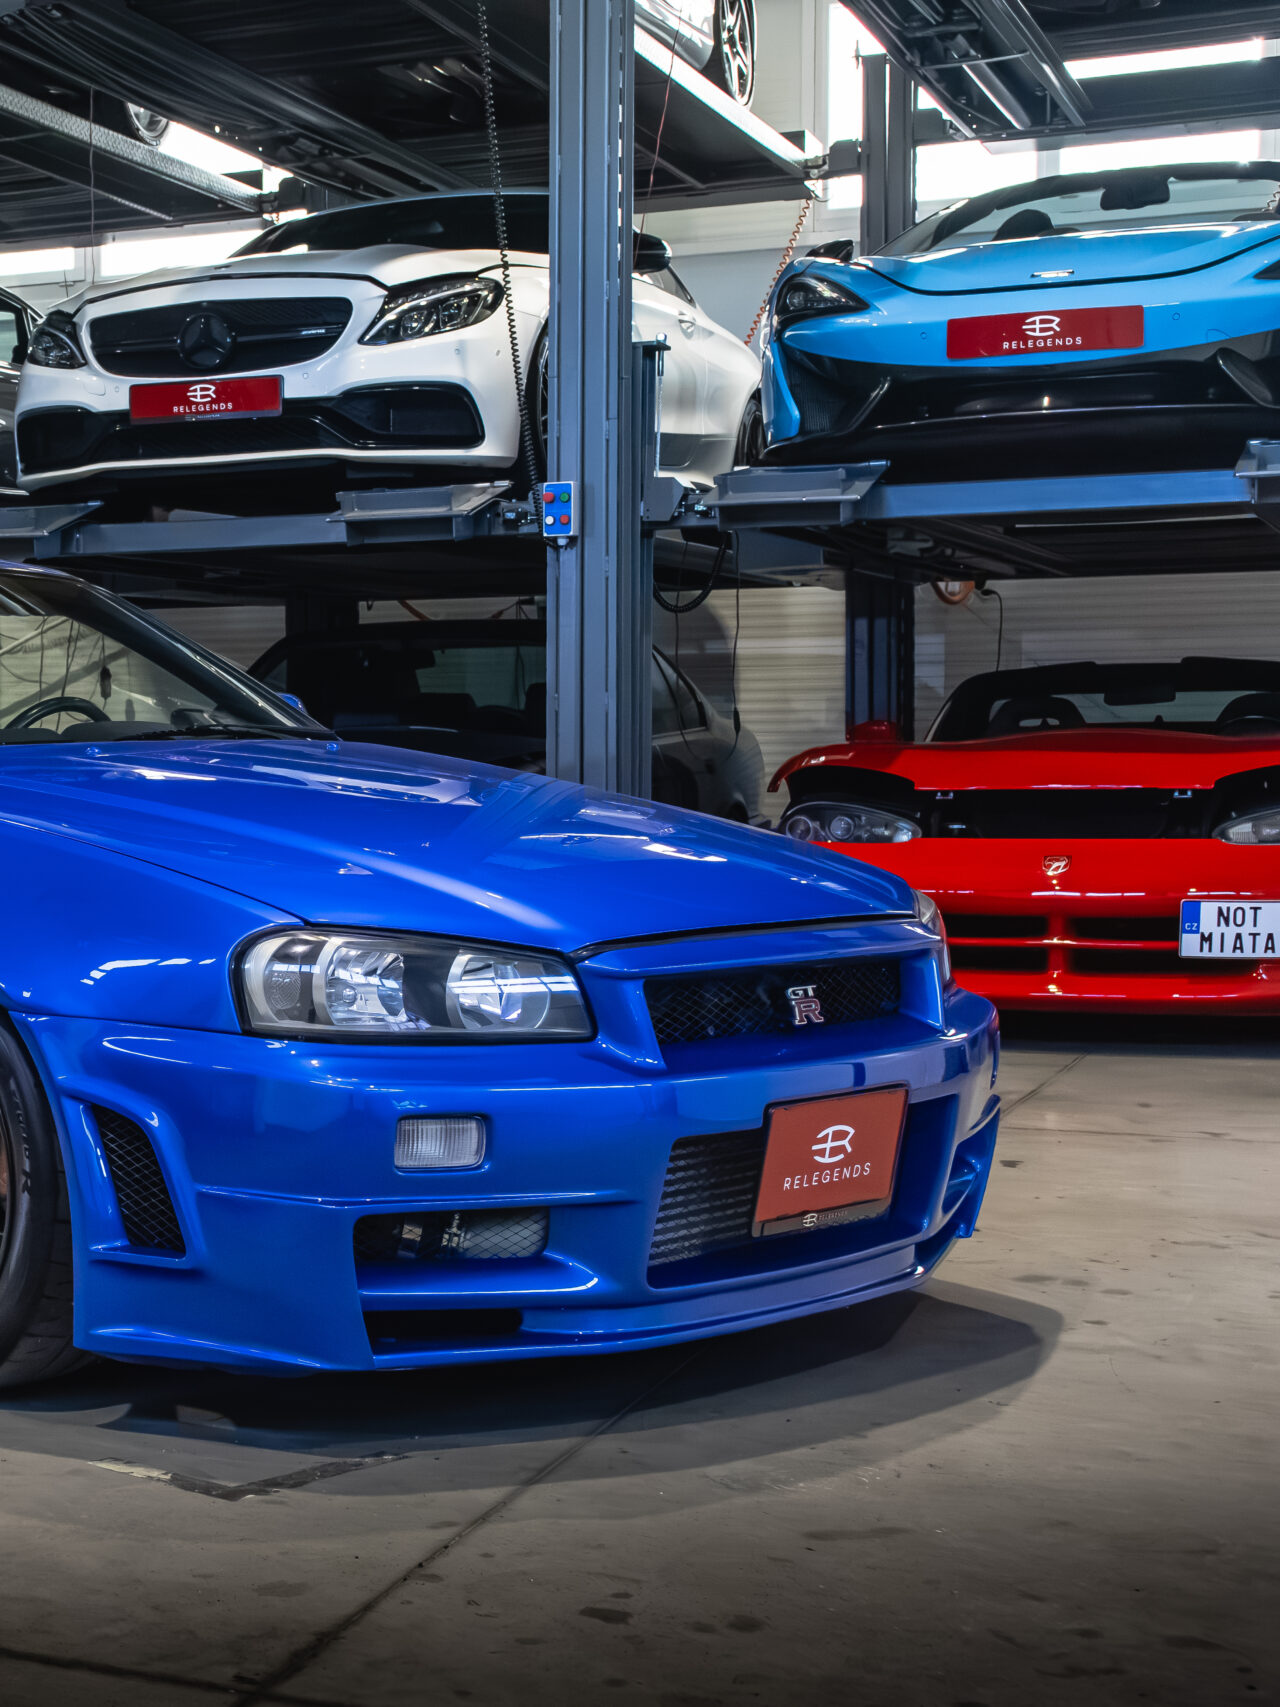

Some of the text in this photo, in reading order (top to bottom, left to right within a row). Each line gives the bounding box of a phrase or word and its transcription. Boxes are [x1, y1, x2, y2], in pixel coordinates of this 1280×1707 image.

[1002, 337, 1083, 350] RELEGENDS
[173, 402, 233, 413] RELEGENDS
[1217, 906, 1262, 927] NOT
[1185, 922, 1198, 931] CZ
[1199, 931, 1276, 953] MIATA
[787, 985, 817, 999] GT
[792, 998, 824, 1025] R
[783, 1162, 872, 1191] RELEGENDS
